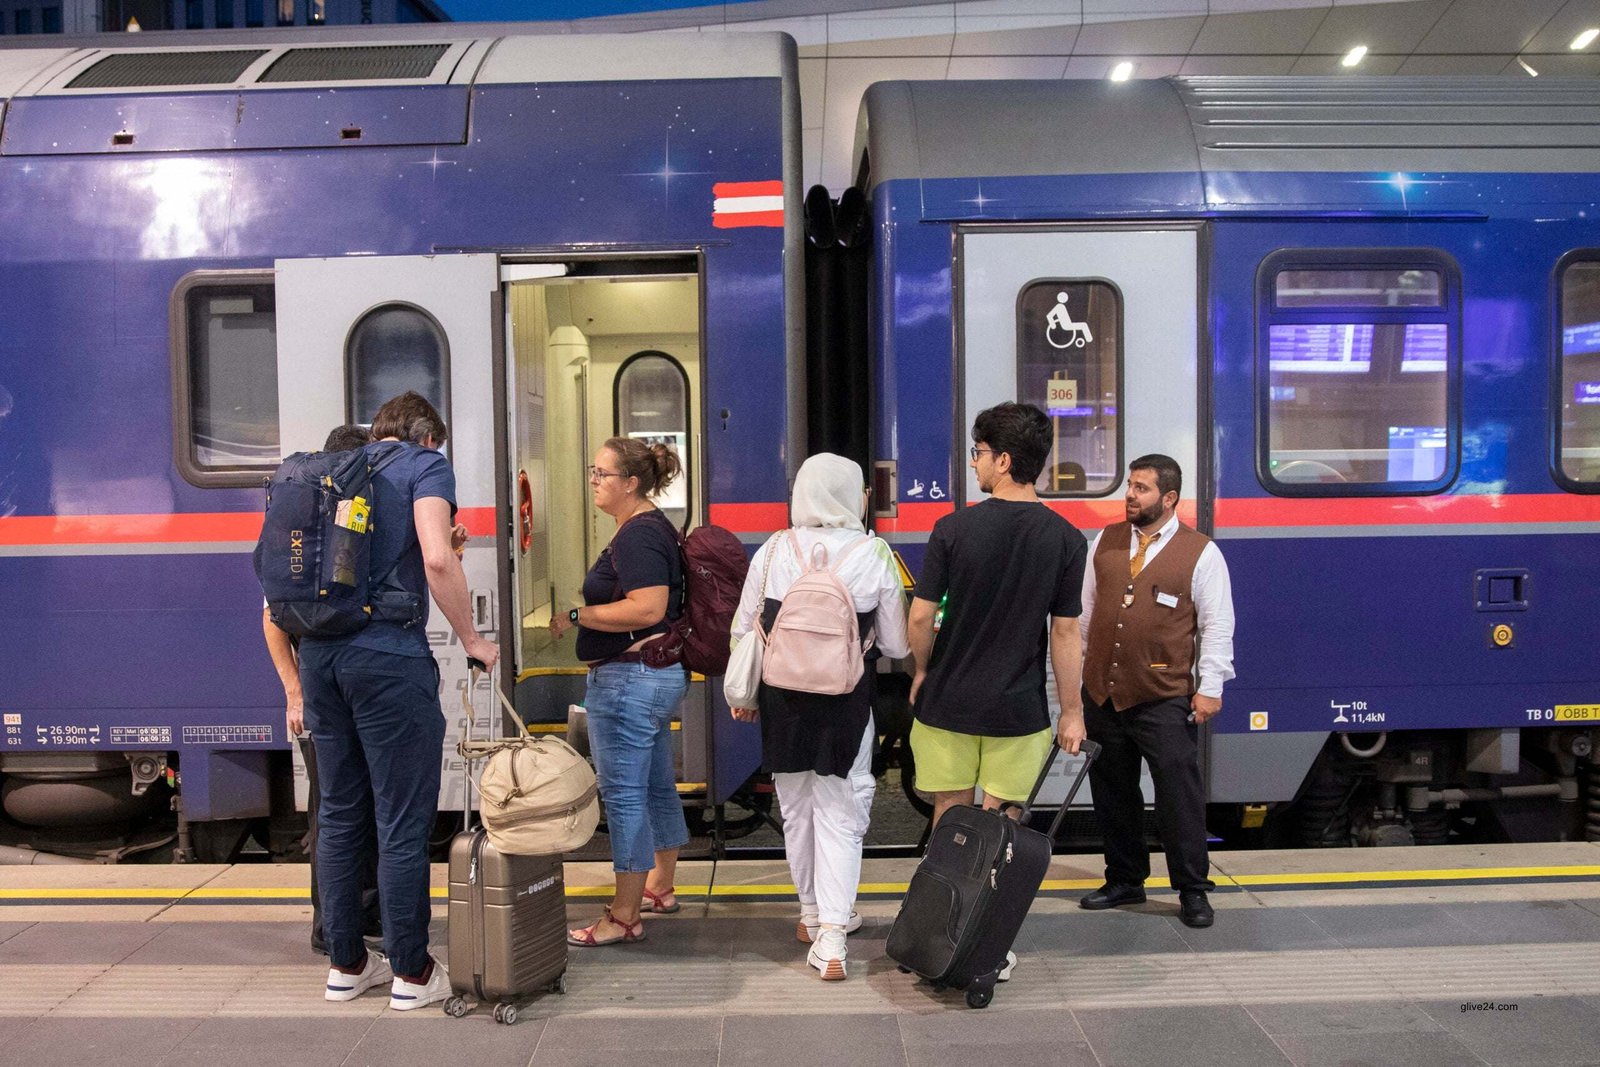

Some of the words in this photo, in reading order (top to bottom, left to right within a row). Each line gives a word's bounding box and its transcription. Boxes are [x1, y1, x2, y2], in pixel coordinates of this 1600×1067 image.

[1051, 389, 1073, 400] 306
[290, 530, 303, 573] EXPED
[1351, 701, 1367, 710] 10t
[1351, 712, 1385, 724] 11,4kN
[1525, 708, 1542, 720] TB
[1563, 706, 1589, 719] ÖBB
[50, 725, 87, 735] 26.90m
[52, 735, 87, 745] 19.90m
[1415, 756, 1429, 766] 4R
